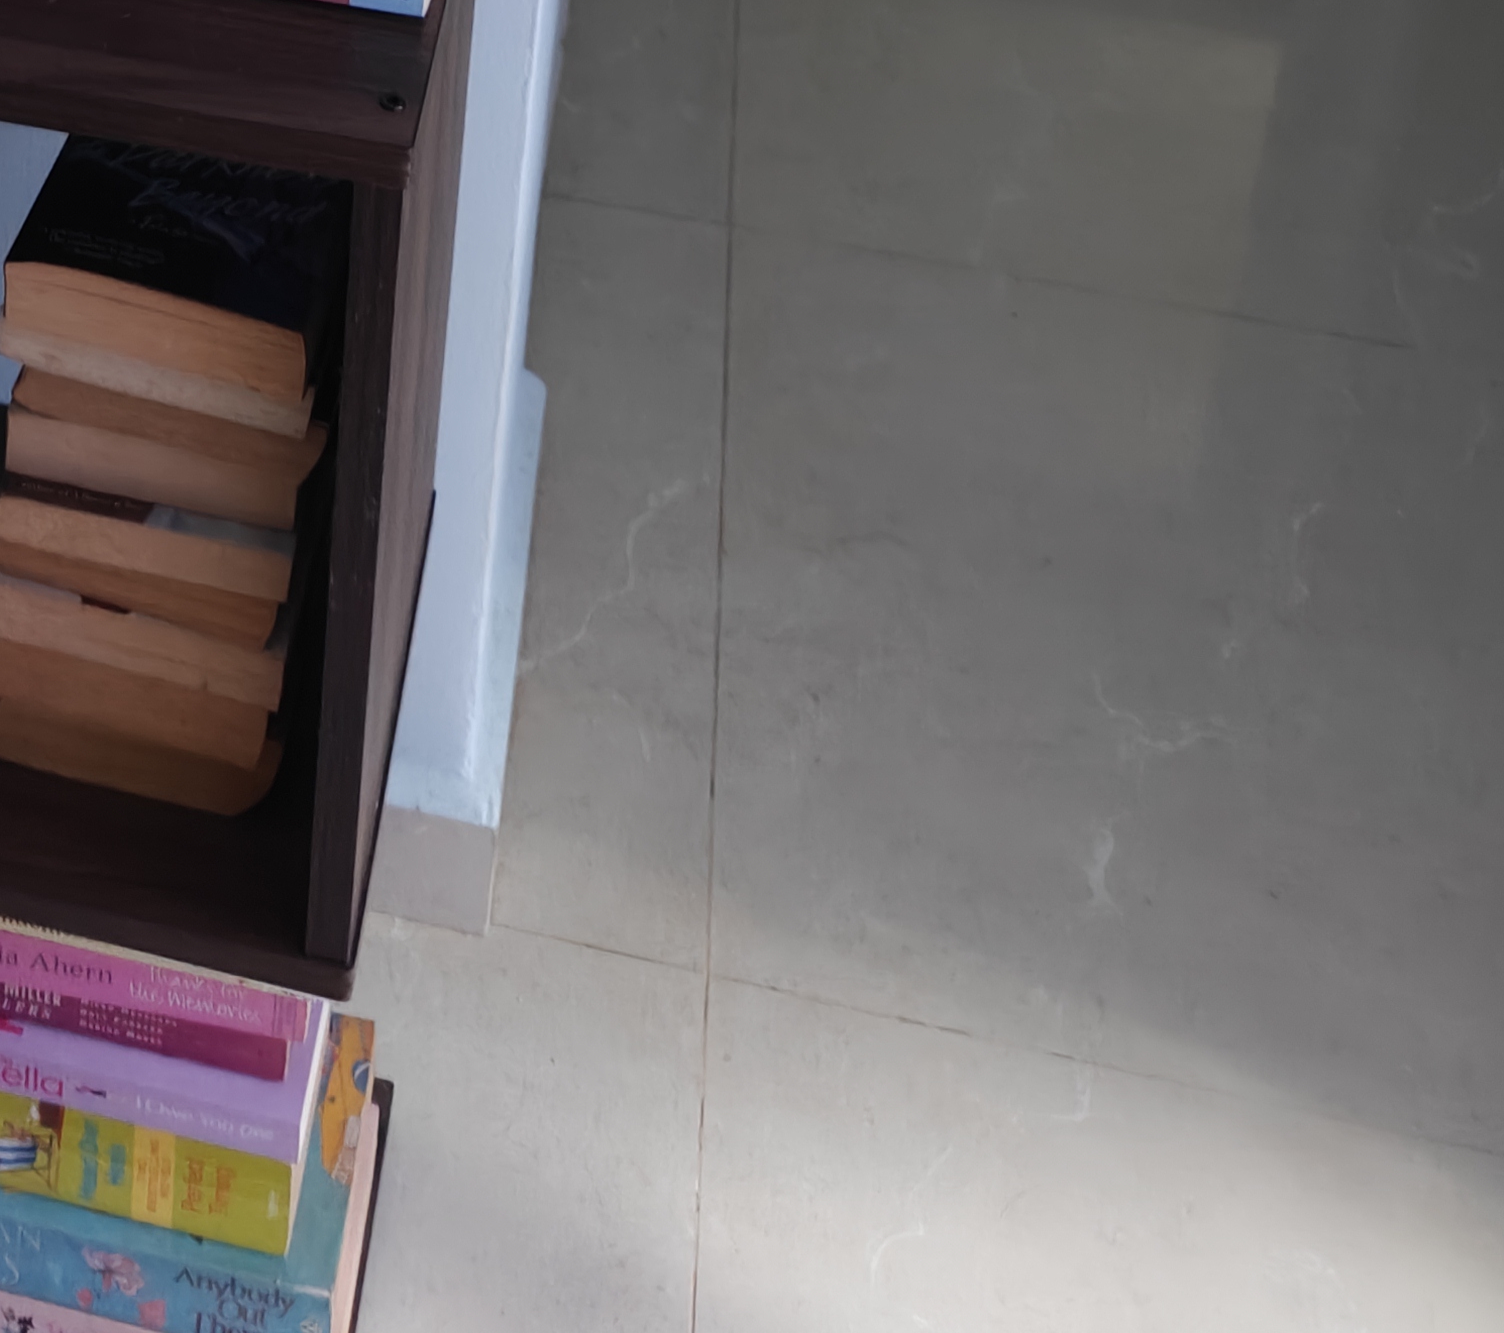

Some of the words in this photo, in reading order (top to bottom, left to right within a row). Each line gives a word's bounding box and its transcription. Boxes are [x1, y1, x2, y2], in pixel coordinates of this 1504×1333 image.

[29, 951, 114, 985] Ahern
[3, 982, 62, 1008] MILLER
[173, 1265, 295, 1318] Anybody
[217, 1292, 267, 1327] Out
